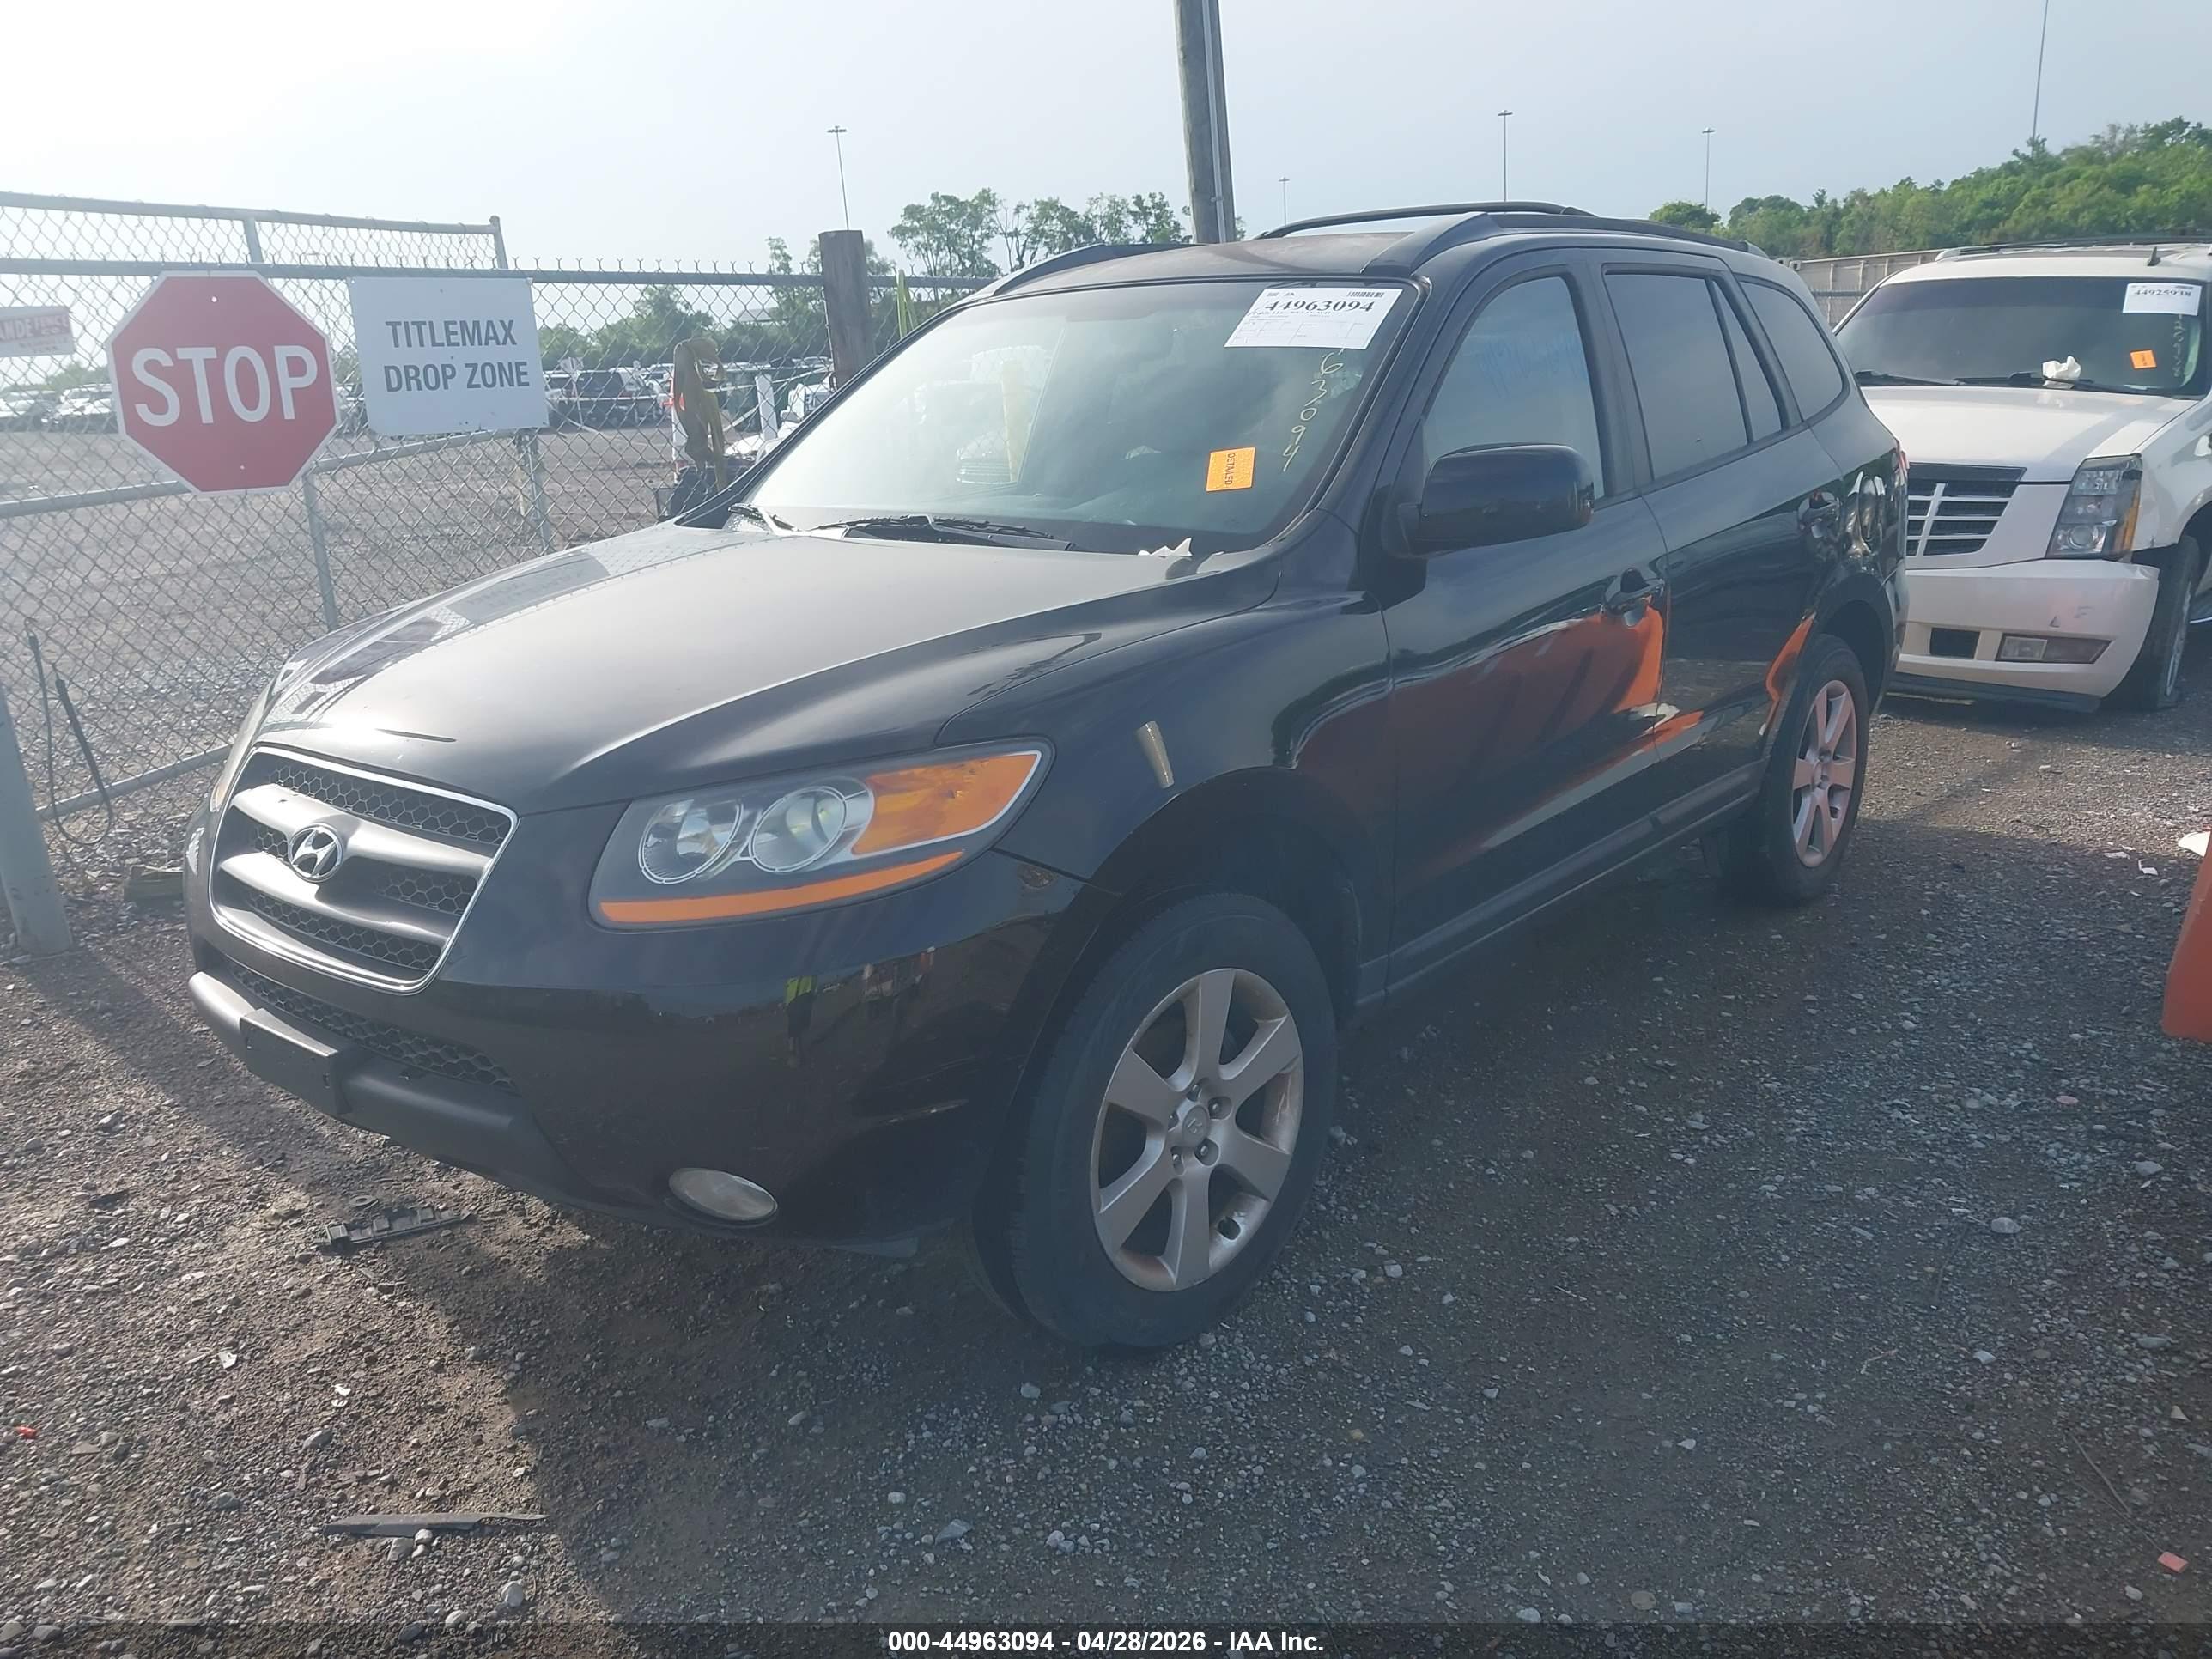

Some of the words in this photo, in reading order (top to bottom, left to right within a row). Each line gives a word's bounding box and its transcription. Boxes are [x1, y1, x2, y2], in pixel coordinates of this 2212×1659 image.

[1265, 300, 1375, 312] 44963094
[385, 319, 517, 348] TITLEMAX
[131, 345, 319, 427] STOP
[384, 363, 457, 392] DROP
[465, 361, 530, 389] ZONE
[1283, 348, 1346, 472] 63094
[1224, 453, 1236, 486] DETAILED
